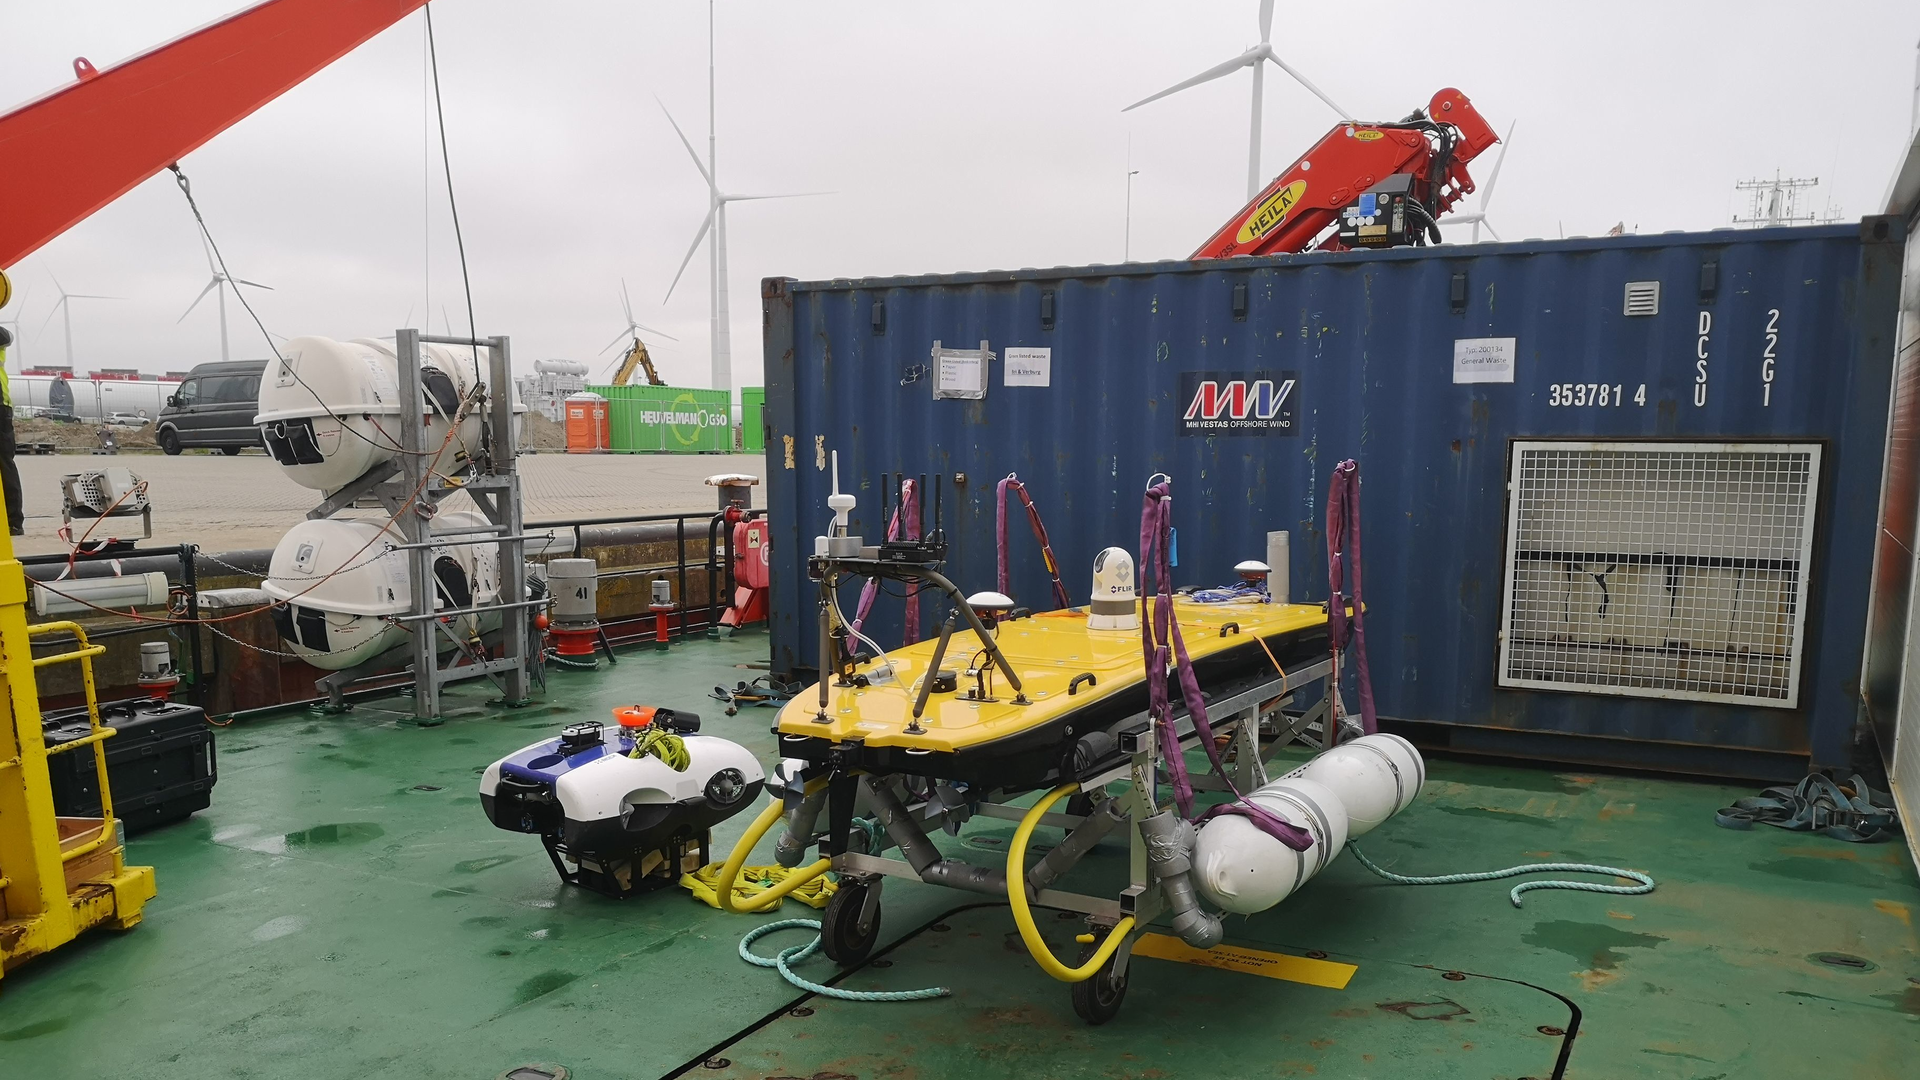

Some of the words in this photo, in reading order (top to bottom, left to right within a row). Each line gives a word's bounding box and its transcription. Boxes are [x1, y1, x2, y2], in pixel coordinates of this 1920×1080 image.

[1248, 195, 1293, 237] HEILA
[1461, 357, 1485, 365] General
[1693, 310, 1712, 407] DCSU
[1549, 383, 1622, 407] 353781
[1634, 384, 1646, 407] 4
[640, 410, 698, 425] HEUVELMAN
[1200, 420, 1229, 428] VESTAS
[1230, 420, 1267, 428] OFFSHORE
[1269, 420, 1291, 428] WIND
[575, 586, 587, 600] 41
